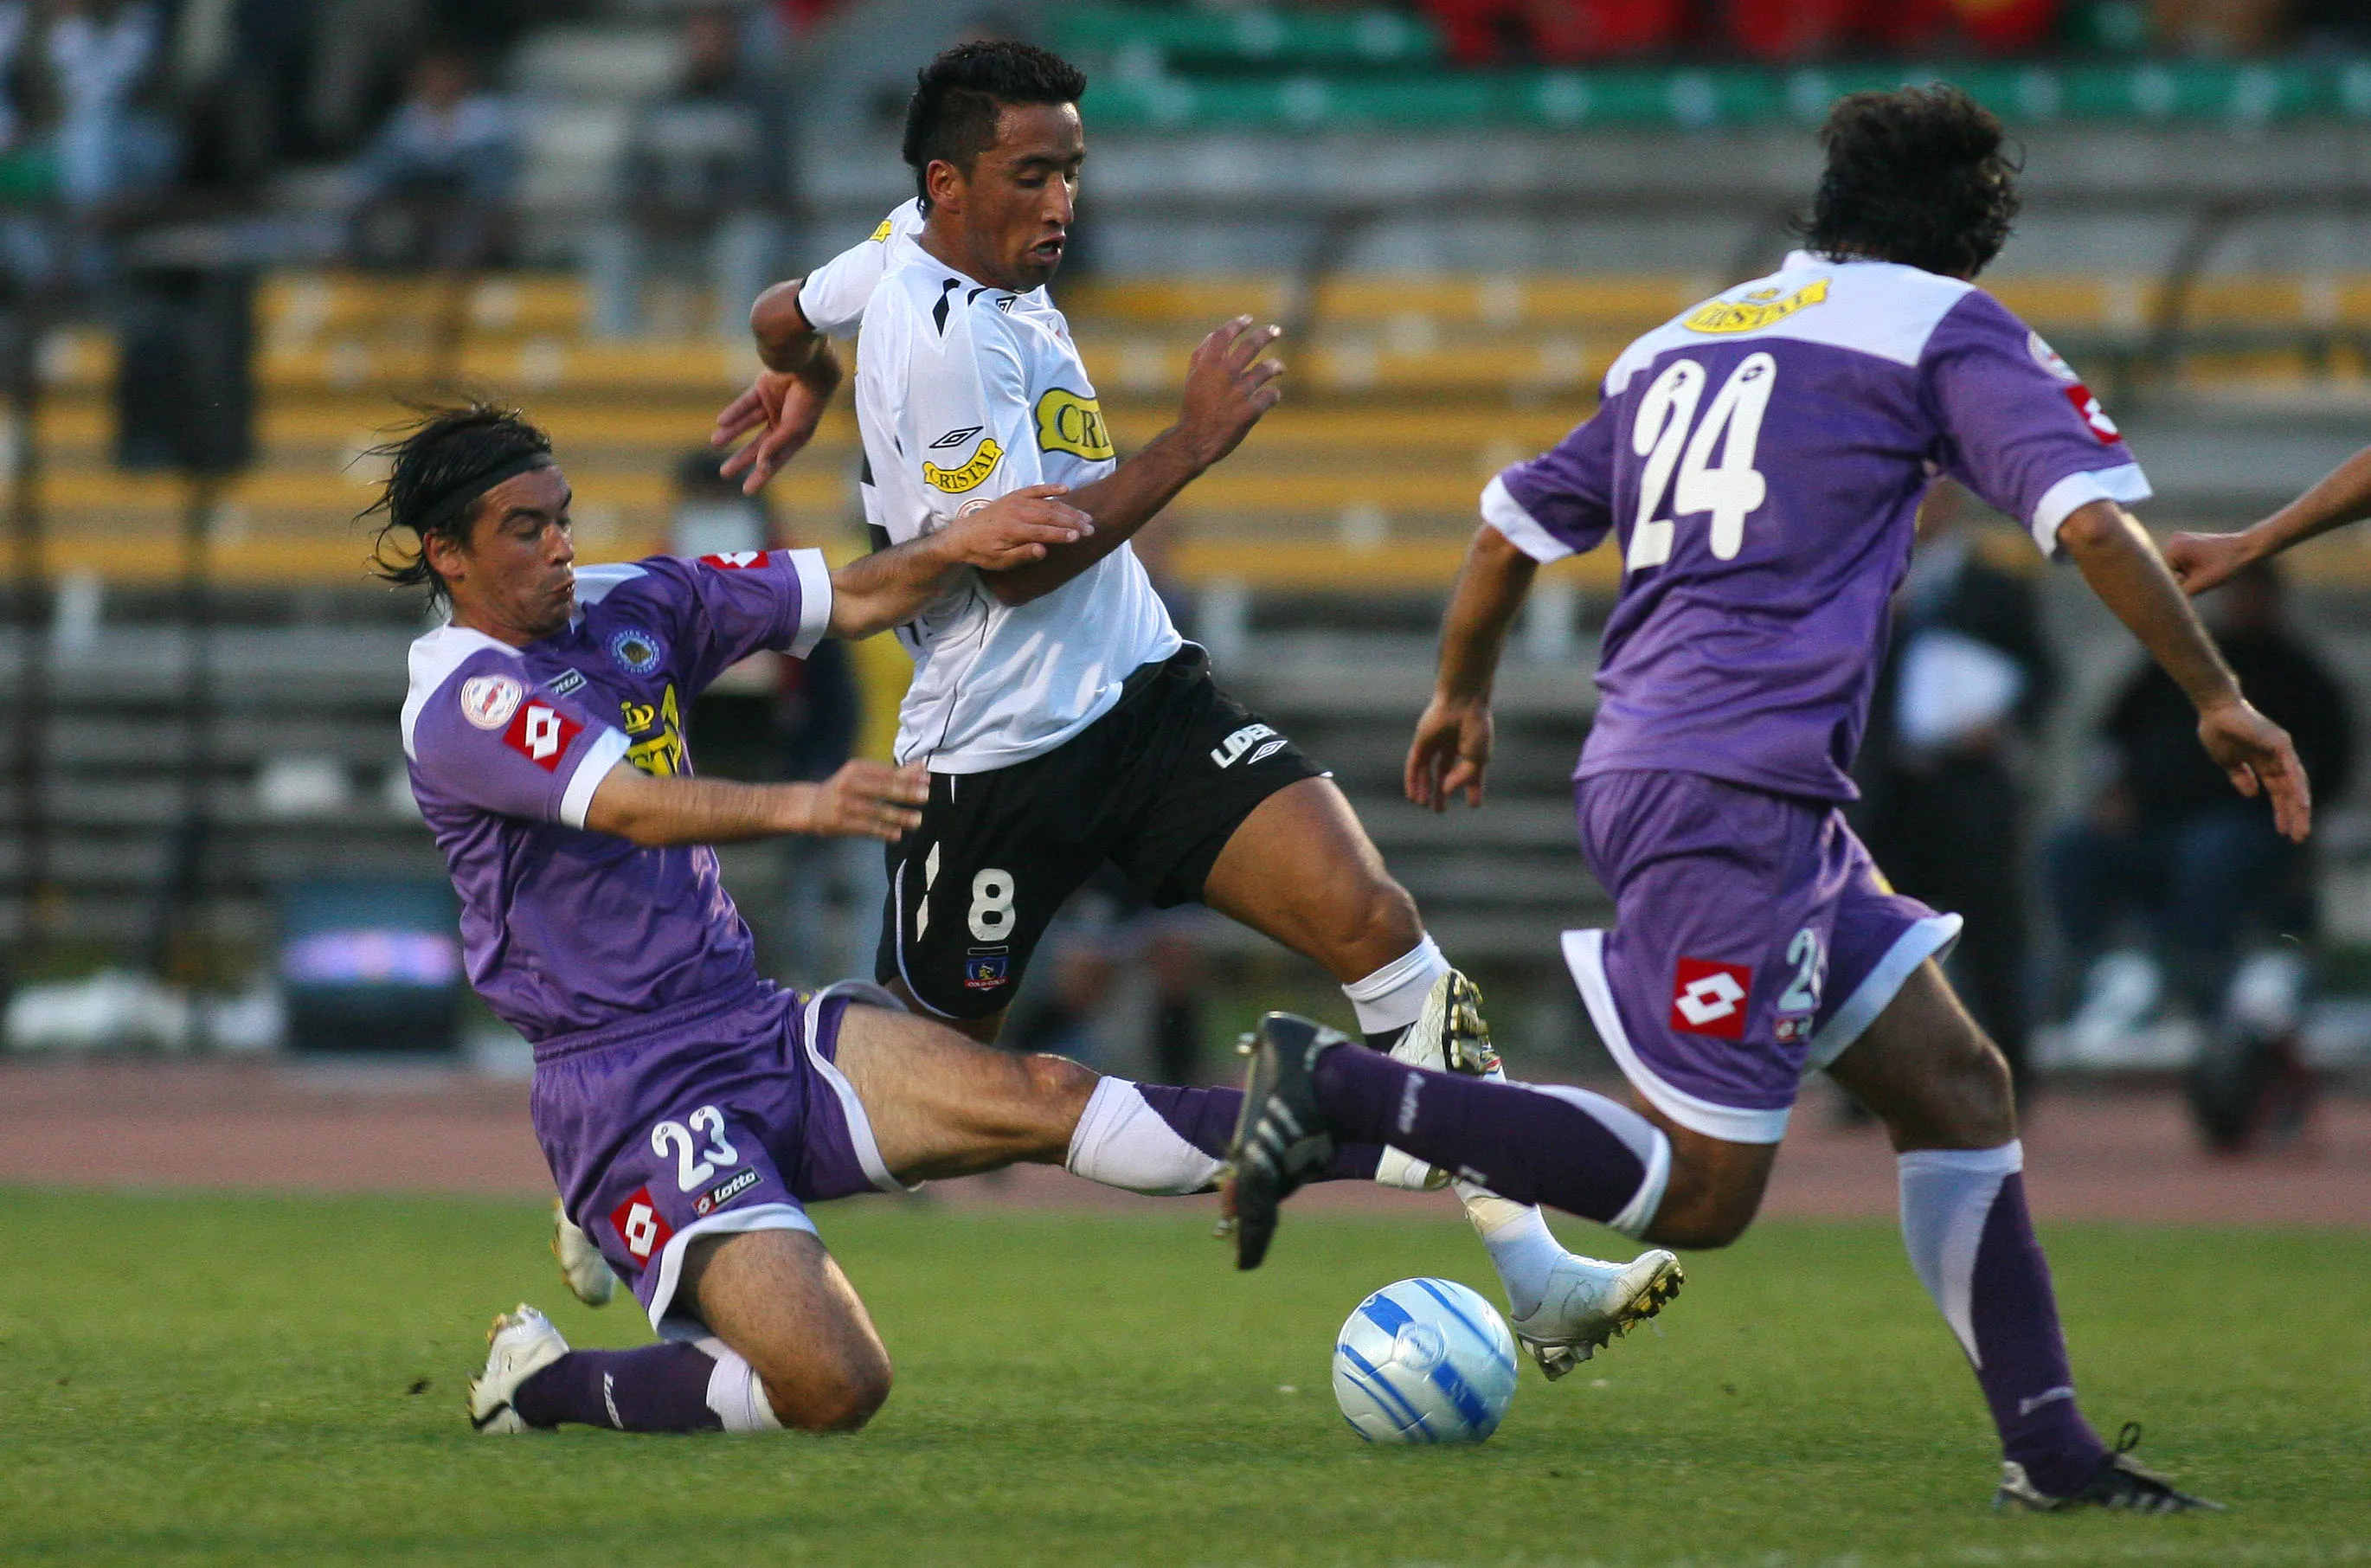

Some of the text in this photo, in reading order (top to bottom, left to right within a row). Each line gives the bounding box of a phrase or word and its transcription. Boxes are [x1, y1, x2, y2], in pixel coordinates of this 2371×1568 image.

[929, 452, 997, 489] CRISTAL
[1626, 351, 1777, 575] 24
[967, 867, 1016, 941] 8
[651, 1104, 738, 1192] 23
